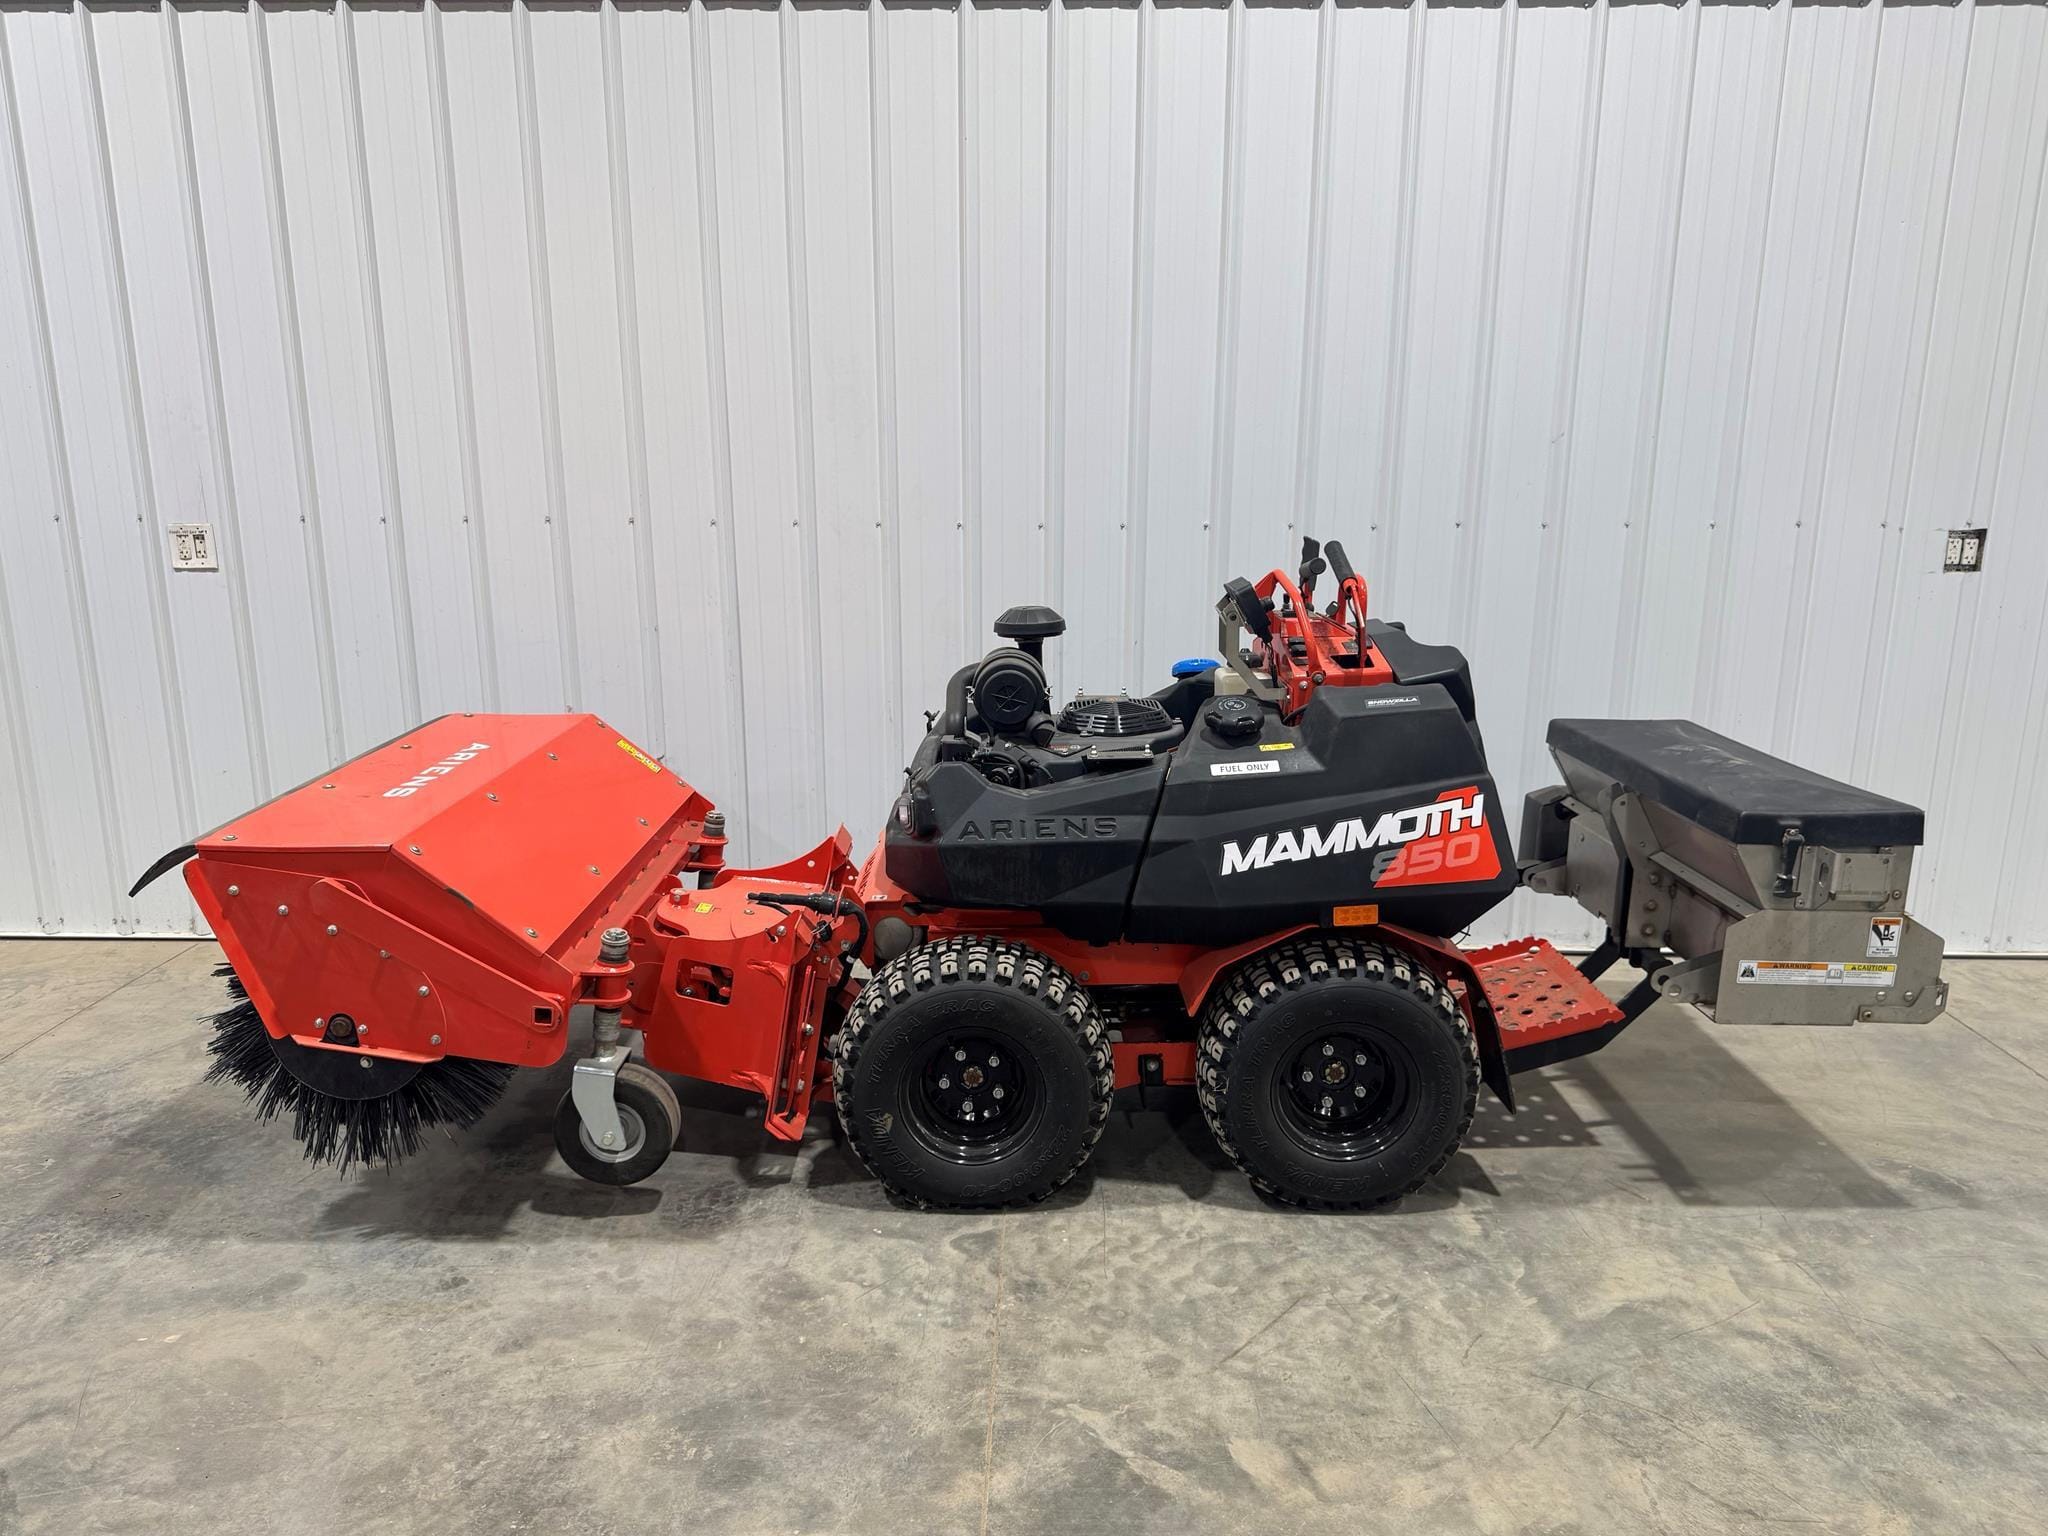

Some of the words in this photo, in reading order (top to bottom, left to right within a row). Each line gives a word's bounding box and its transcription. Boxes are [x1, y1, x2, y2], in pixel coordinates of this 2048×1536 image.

[382, 742, 491, 798] ARIENS
[1219, 764, 1243, 773] FUEL
[1246, 762, 1270, 772] ONLY
[957, 817, 1119, 842] ARIENS
[1220, 793, 1485, 877] MAMMOTH
[1369, 832, 1480, 883] 850
